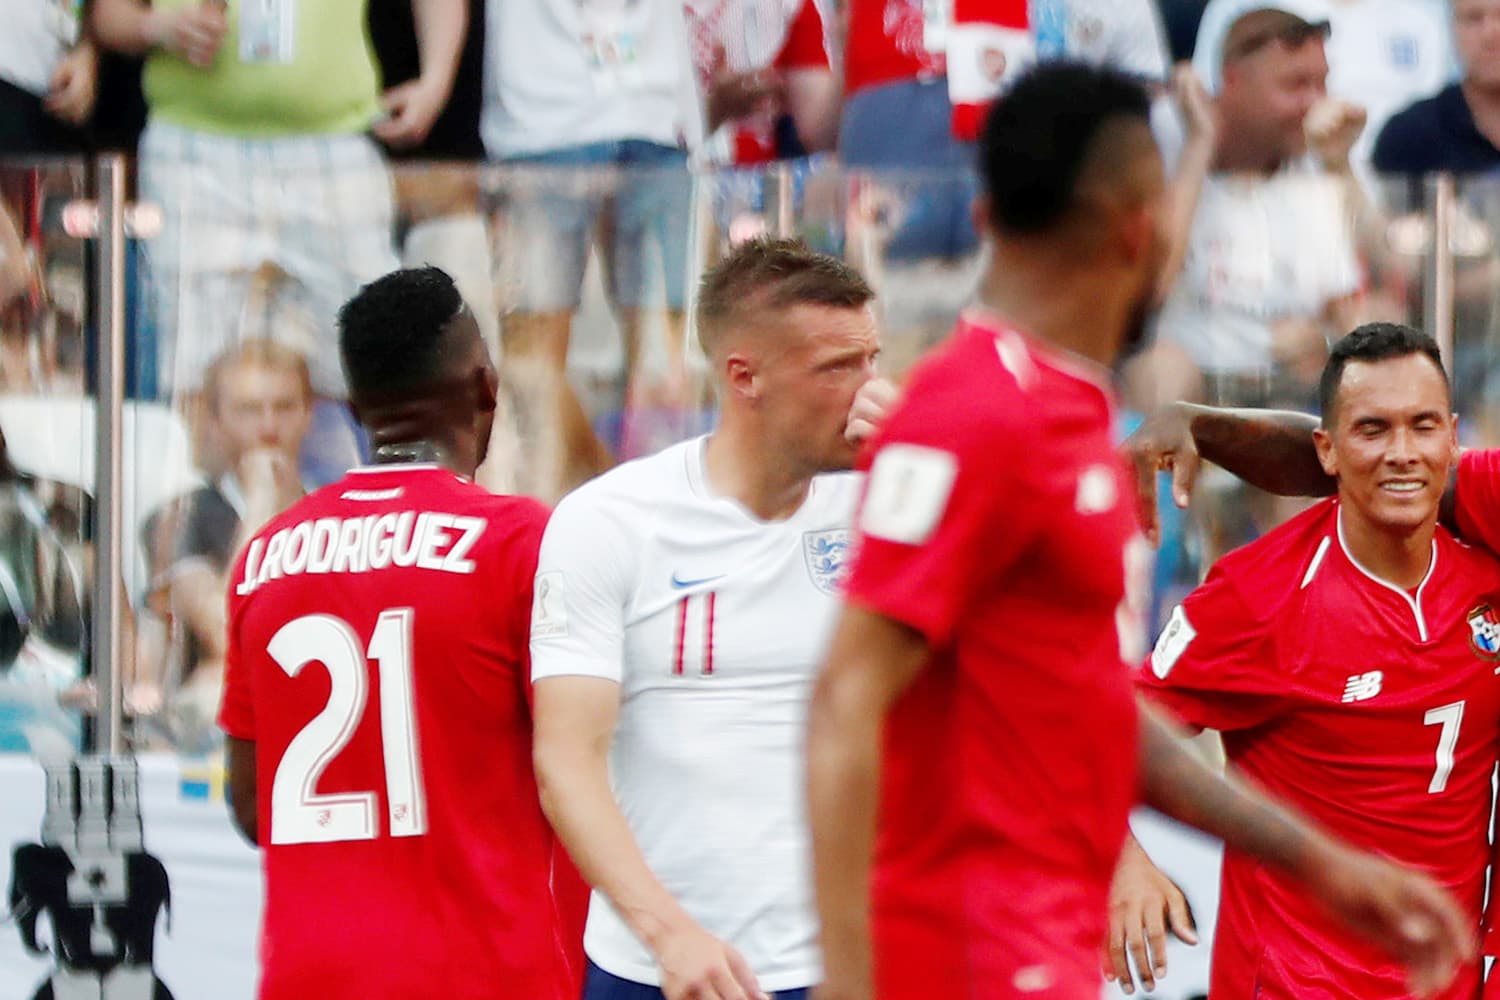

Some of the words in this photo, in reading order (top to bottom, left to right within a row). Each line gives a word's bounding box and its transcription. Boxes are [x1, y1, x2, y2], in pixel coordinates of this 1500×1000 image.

[236, 510, 488, 596] J.RODRIGUEZ
[671, 591, 716, 676] 11
[266, 606, 428, 846] 21
[1423, 700, 1466, 794] 7
